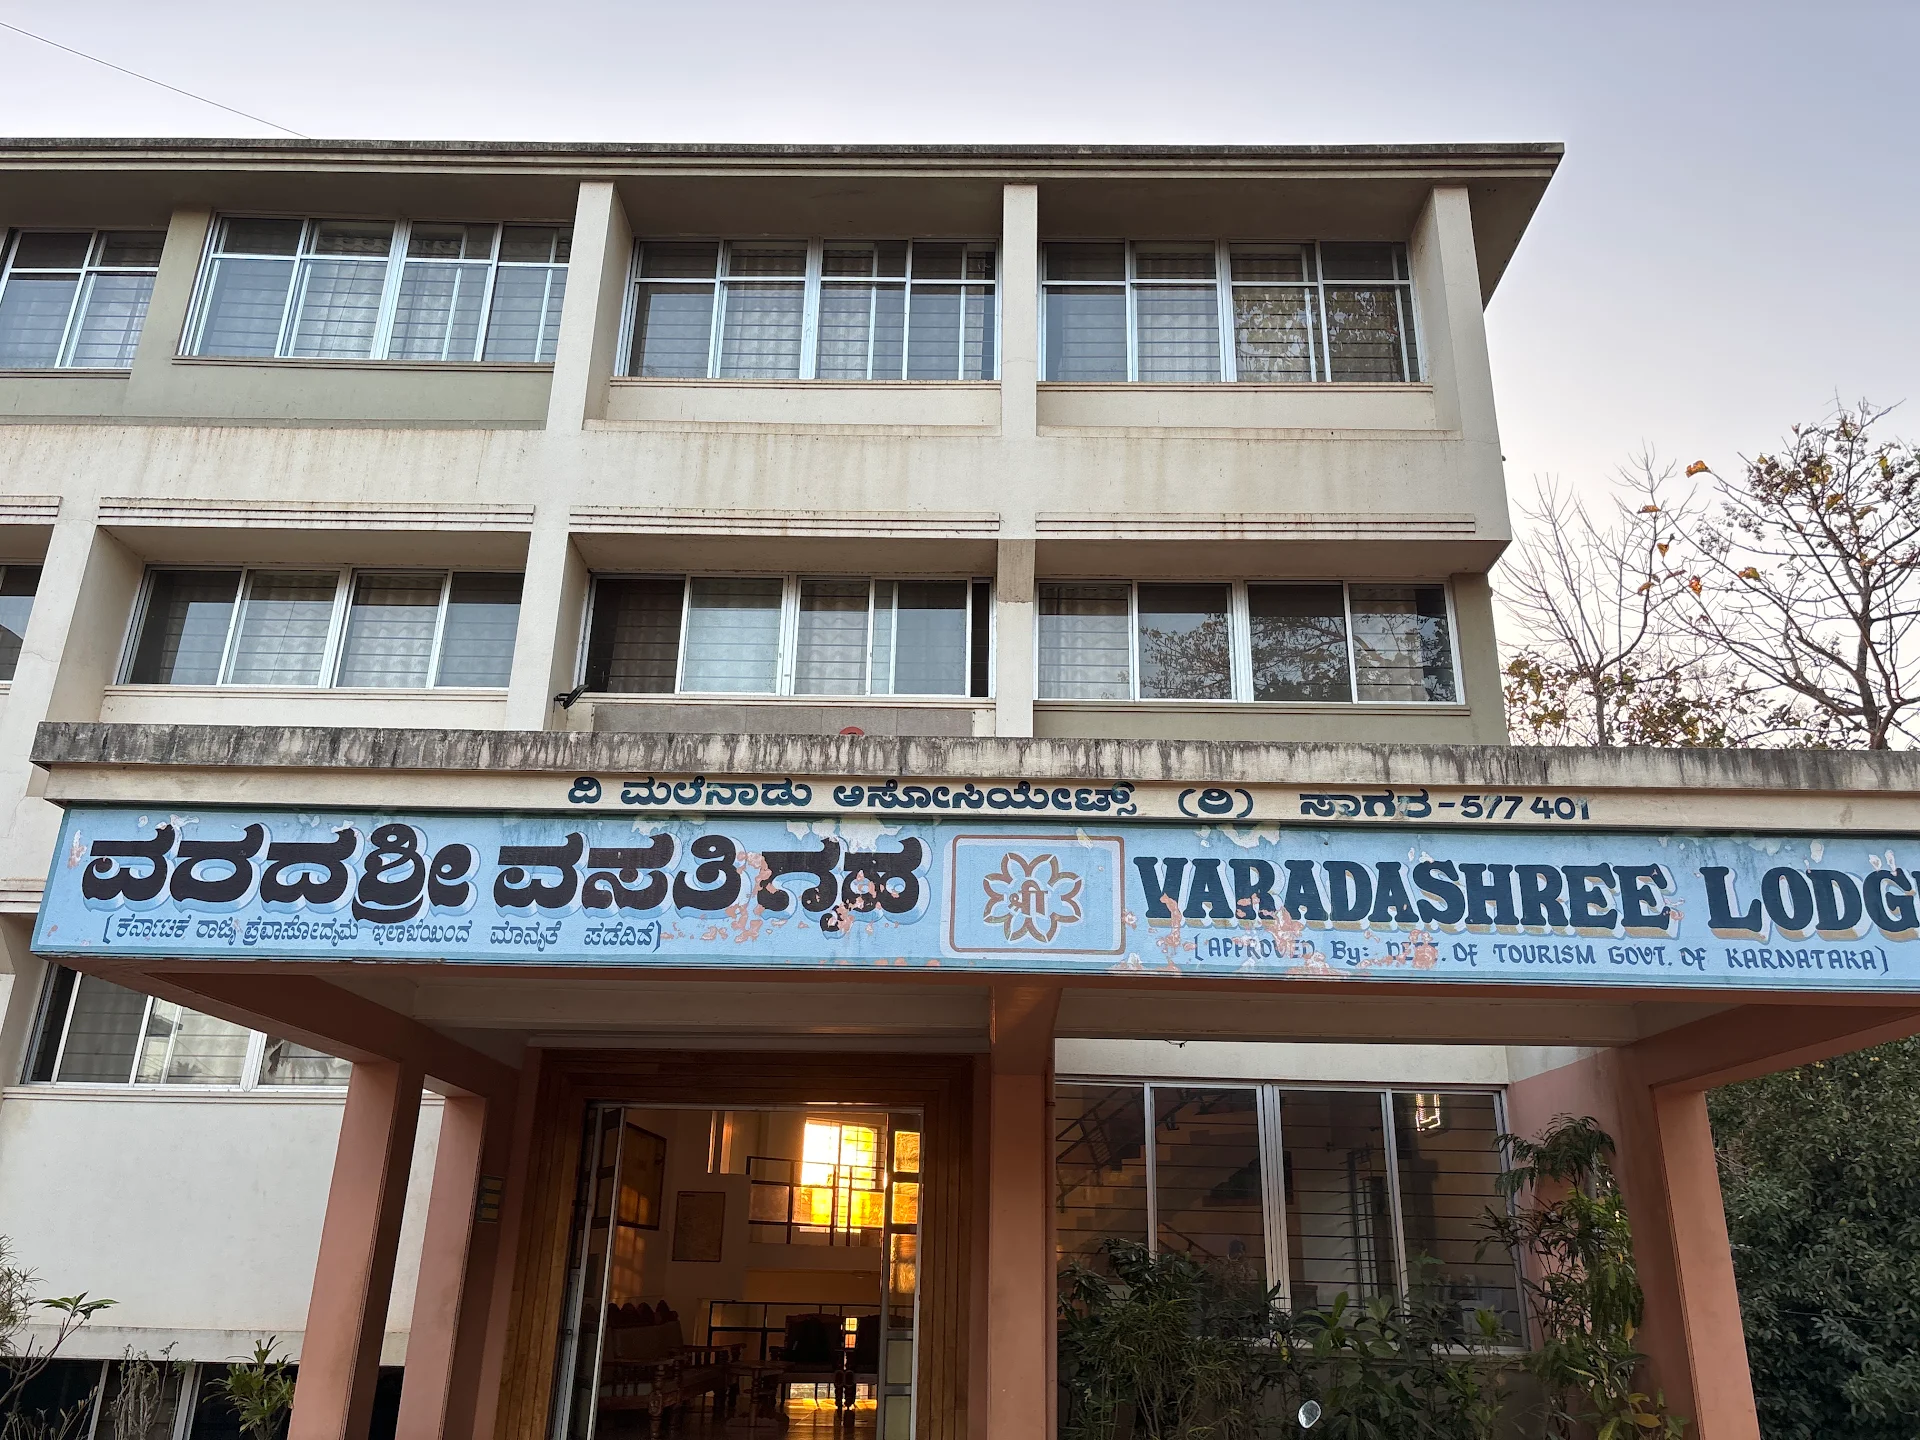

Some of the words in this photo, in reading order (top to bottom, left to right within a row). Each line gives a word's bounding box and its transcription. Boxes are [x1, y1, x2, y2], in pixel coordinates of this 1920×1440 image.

[568, 777, 602, 804] ದಿ
[620, 775, 813, 807] ಮಲೆನಾಡು
[82, 822, 473, 922] ವರದಶ್ರೀ
[1133, 856, 1670, 931] VARADASHREE
[1699, 866, 1920, 932] LODG
[1492, 943, 1597, 966] TOURISM
[1607, 944, 1673, 968] GOVT.
